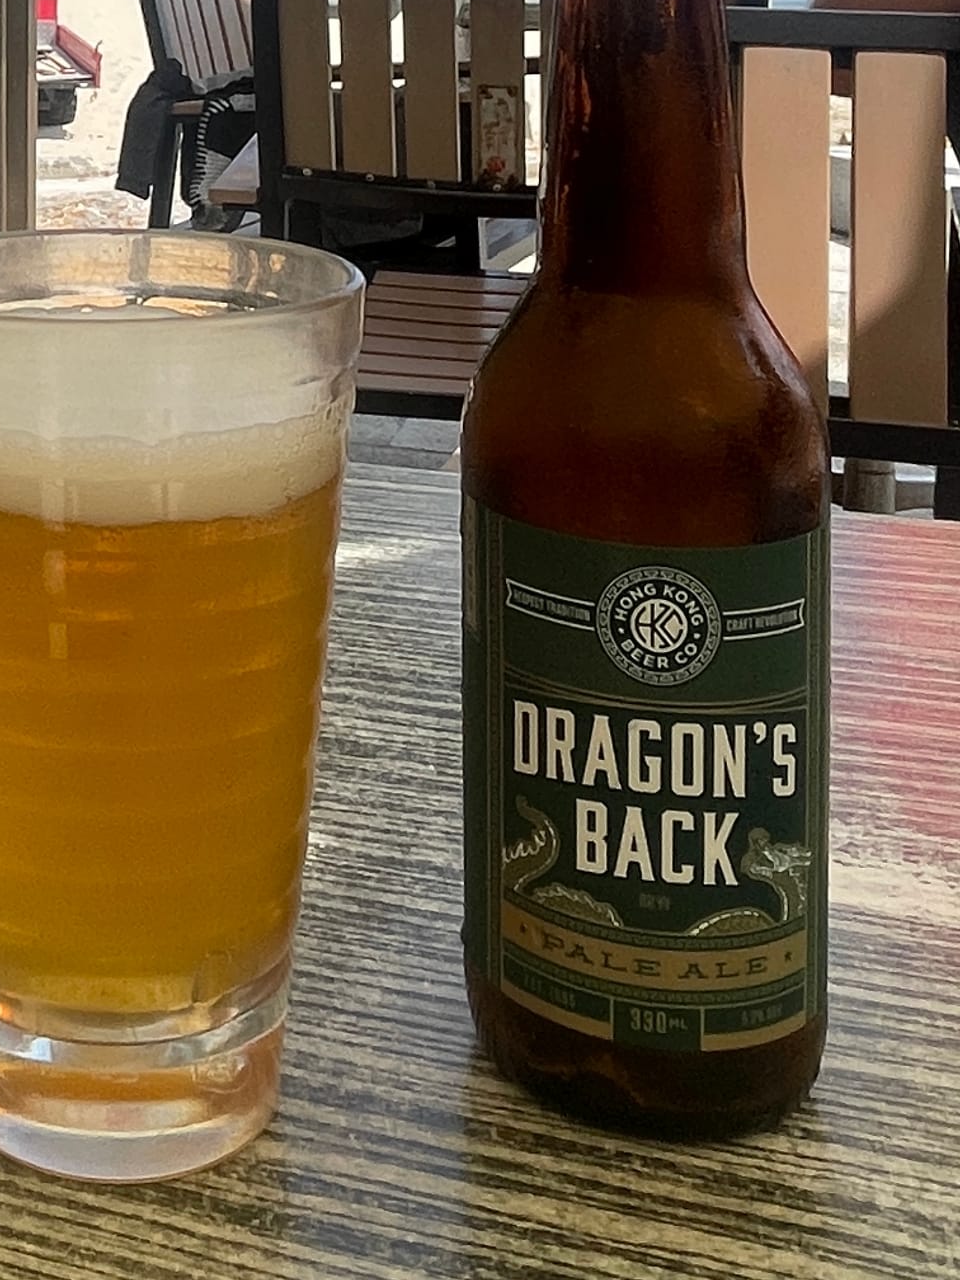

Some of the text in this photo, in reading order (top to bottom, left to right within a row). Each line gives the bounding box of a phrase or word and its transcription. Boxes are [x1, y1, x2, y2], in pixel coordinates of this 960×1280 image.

[613, 582, 704, 626] HONG KONG
[620, 638, 698, 670] BEER CO
[513, 698, 797, 799] DRAGON'S
[575, 797, 740, 886] BACK
[541, 931, 769, 980] PALE ALE
